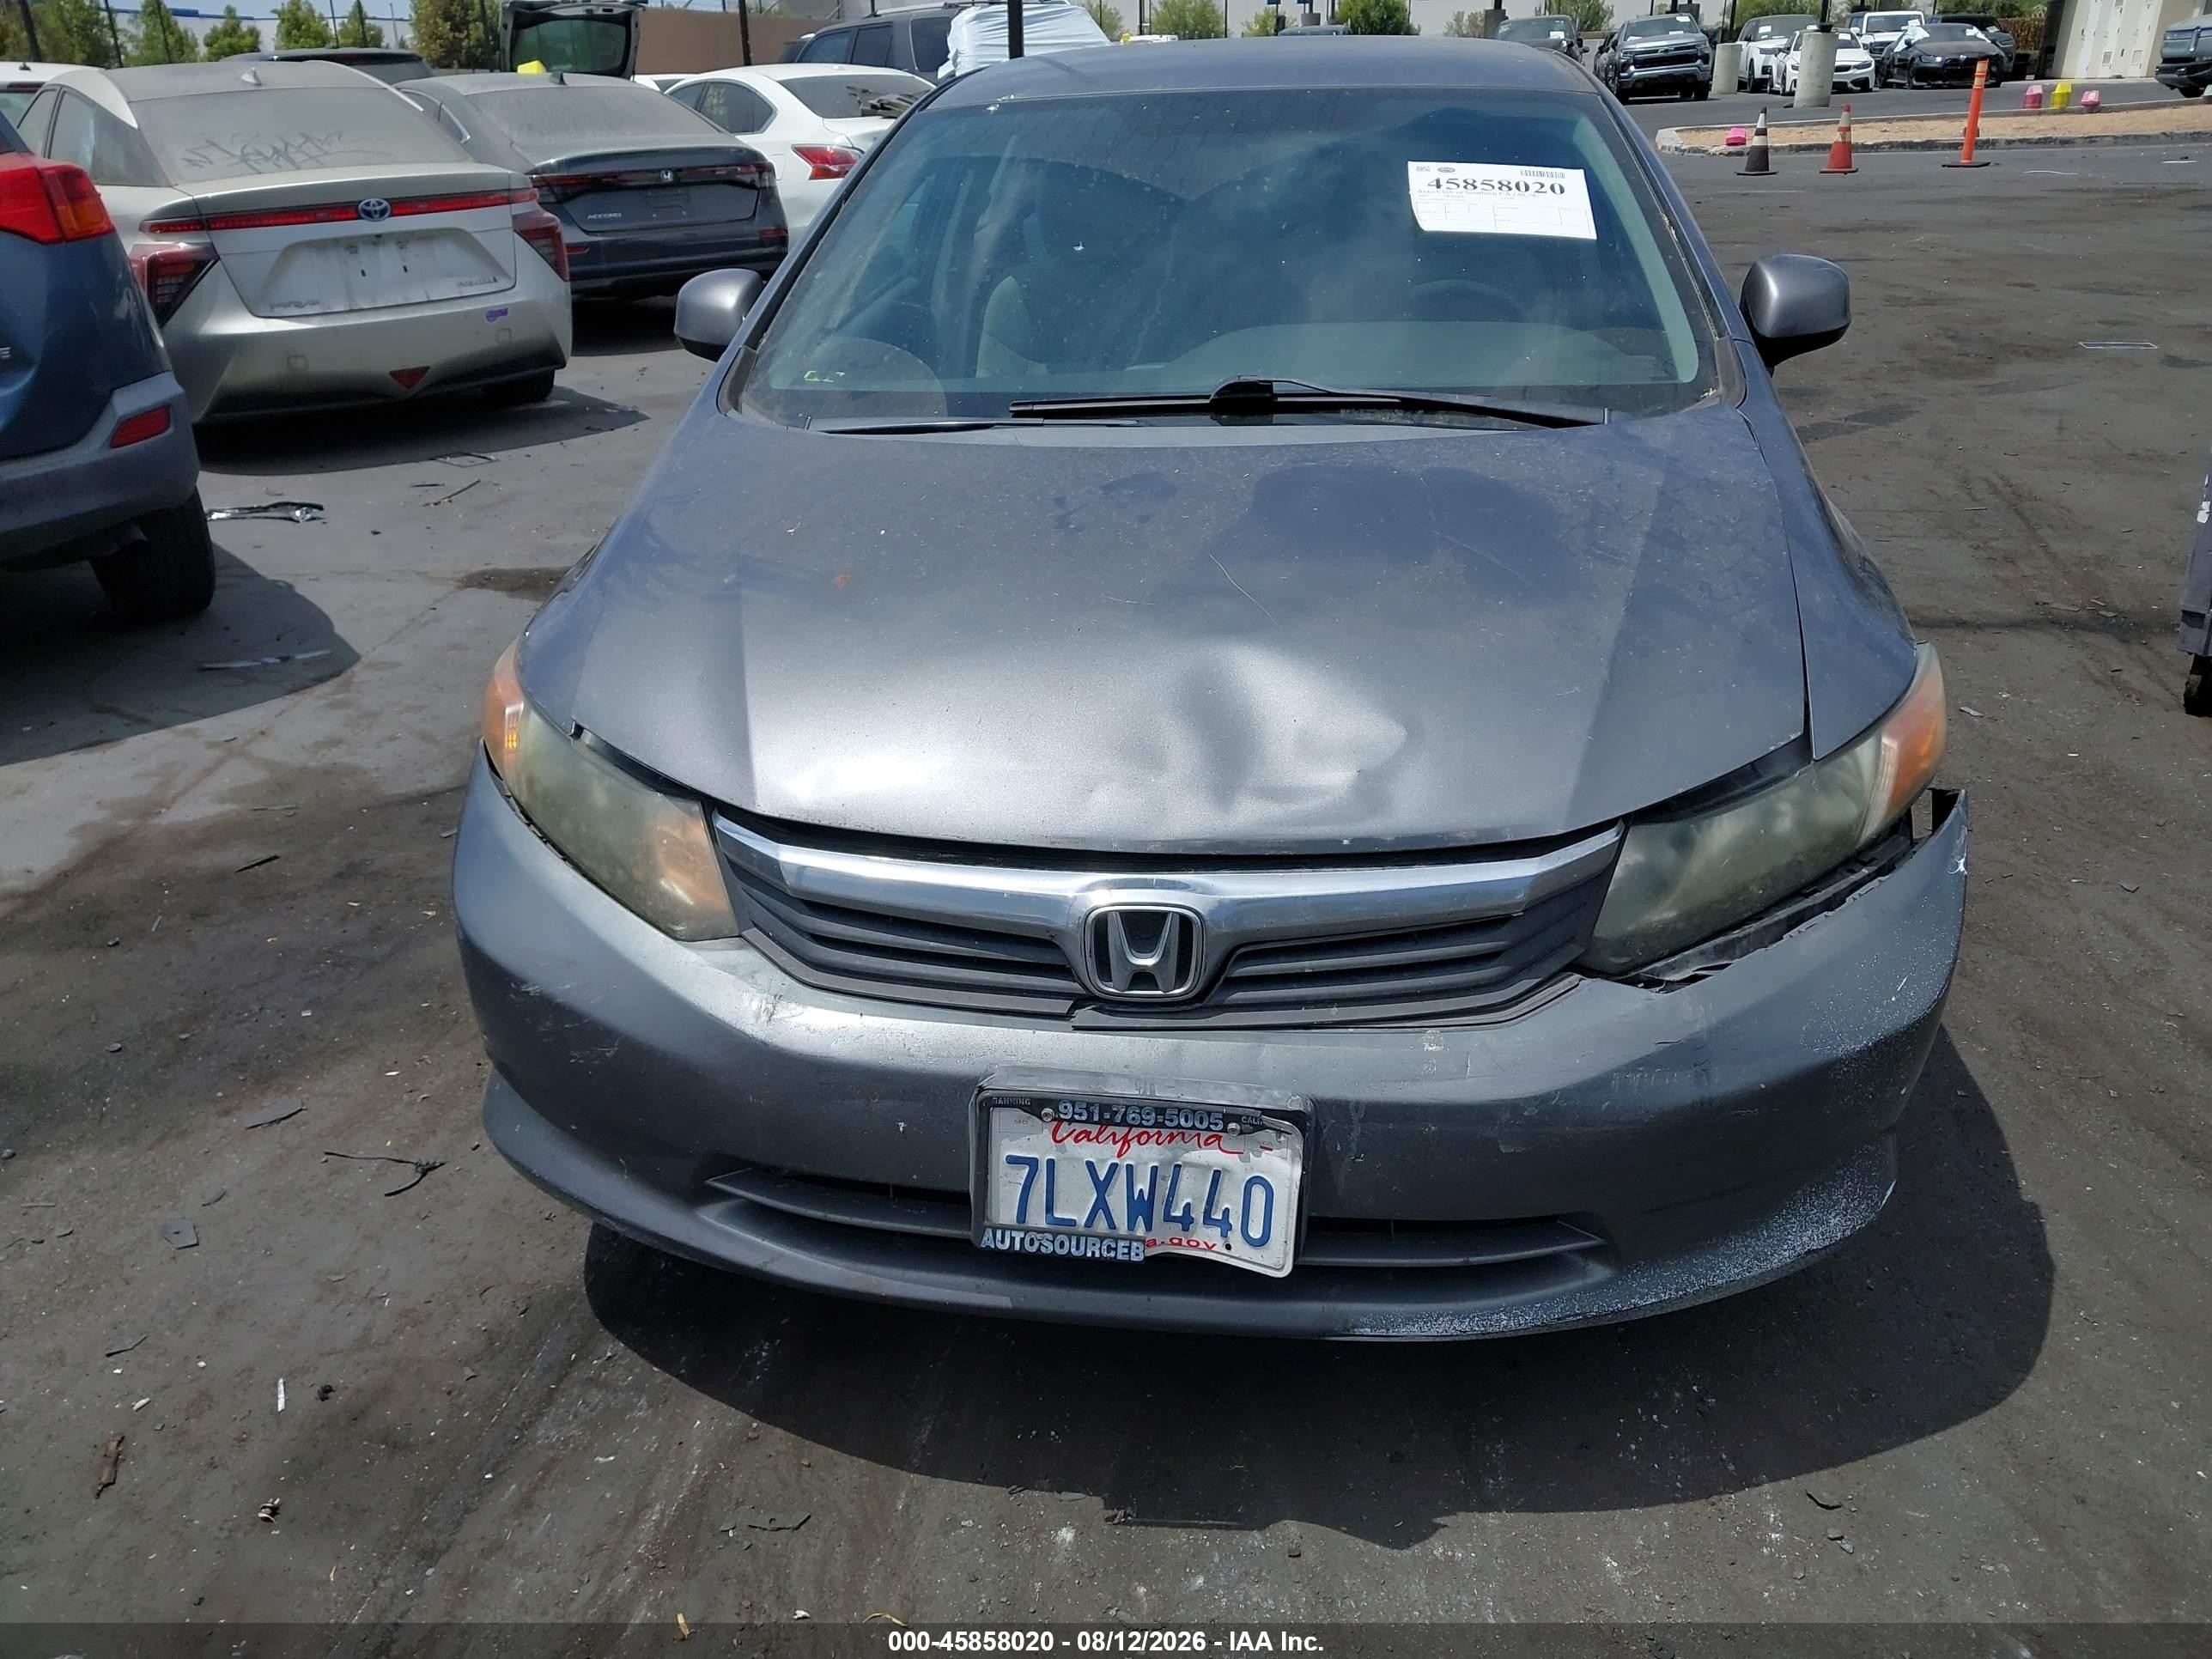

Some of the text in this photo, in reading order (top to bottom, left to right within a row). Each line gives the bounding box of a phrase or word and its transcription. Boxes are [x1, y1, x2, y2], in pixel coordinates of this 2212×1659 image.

[1427, 177, 1565, 196] 45858020
[1058, 1099, 1224, 1131] 951-769-5005
[1051, 1121, 1244, 1158] California
[1005, 1154, 1275, 1249] 7LXW440
[981, 1227, 1146, 1263] AUTOSOURCEB
